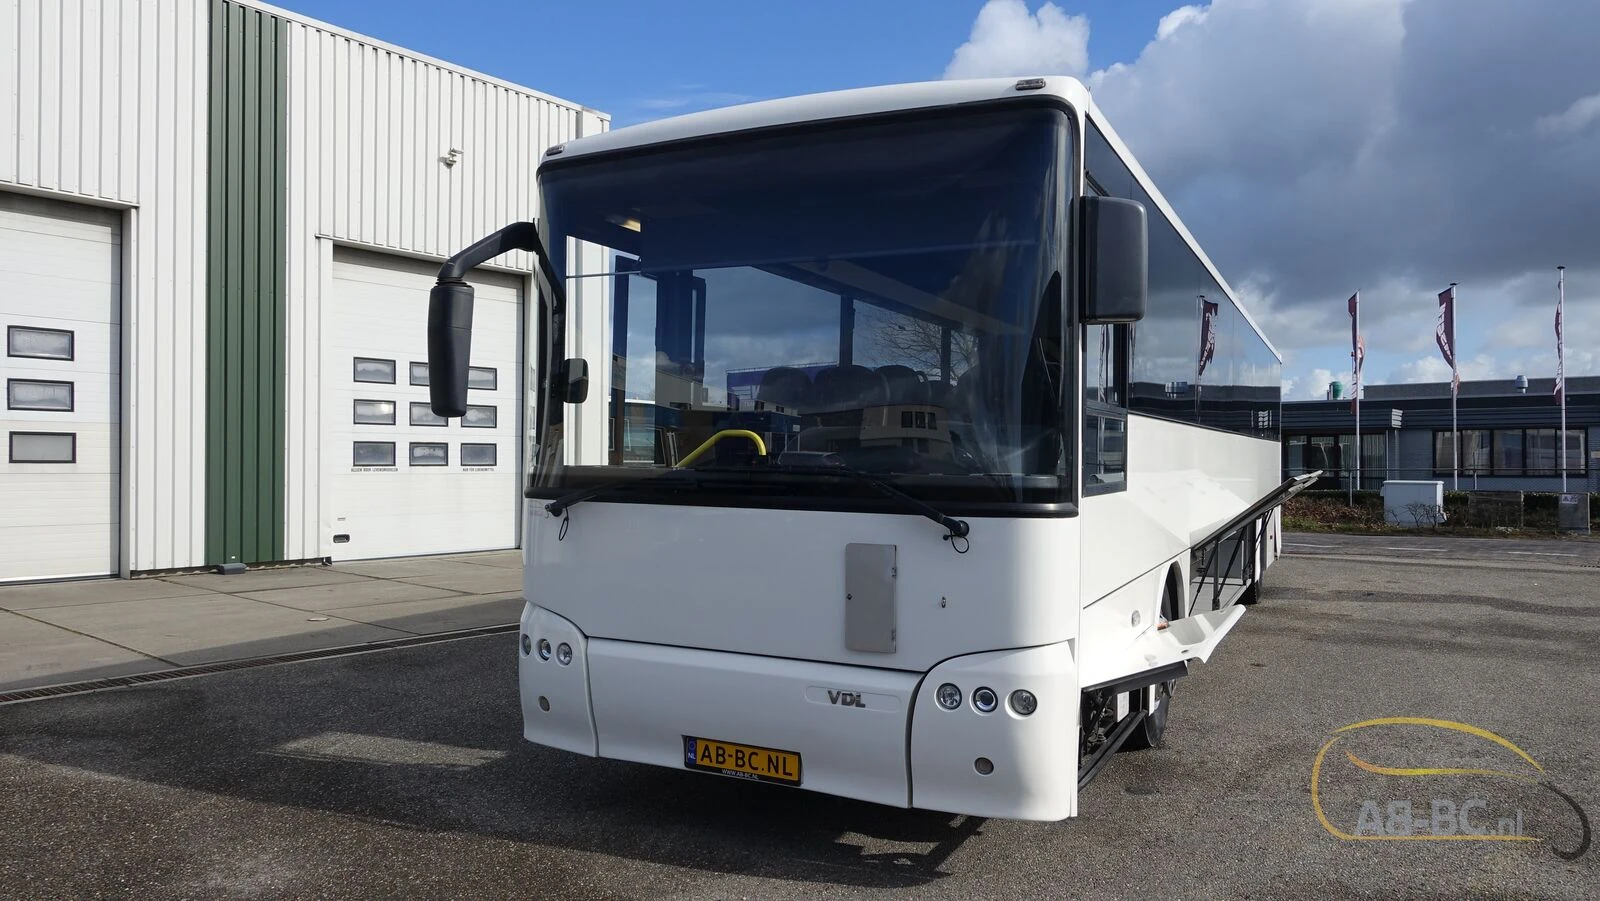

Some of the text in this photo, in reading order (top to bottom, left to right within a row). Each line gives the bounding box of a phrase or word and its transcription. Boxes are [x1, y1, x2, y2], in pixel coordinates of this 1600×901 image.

[827, 690, 866, 708] VDL
[687, 752, 696, 760] NL
[700, 743, 793, 776] AB-BC.NL
